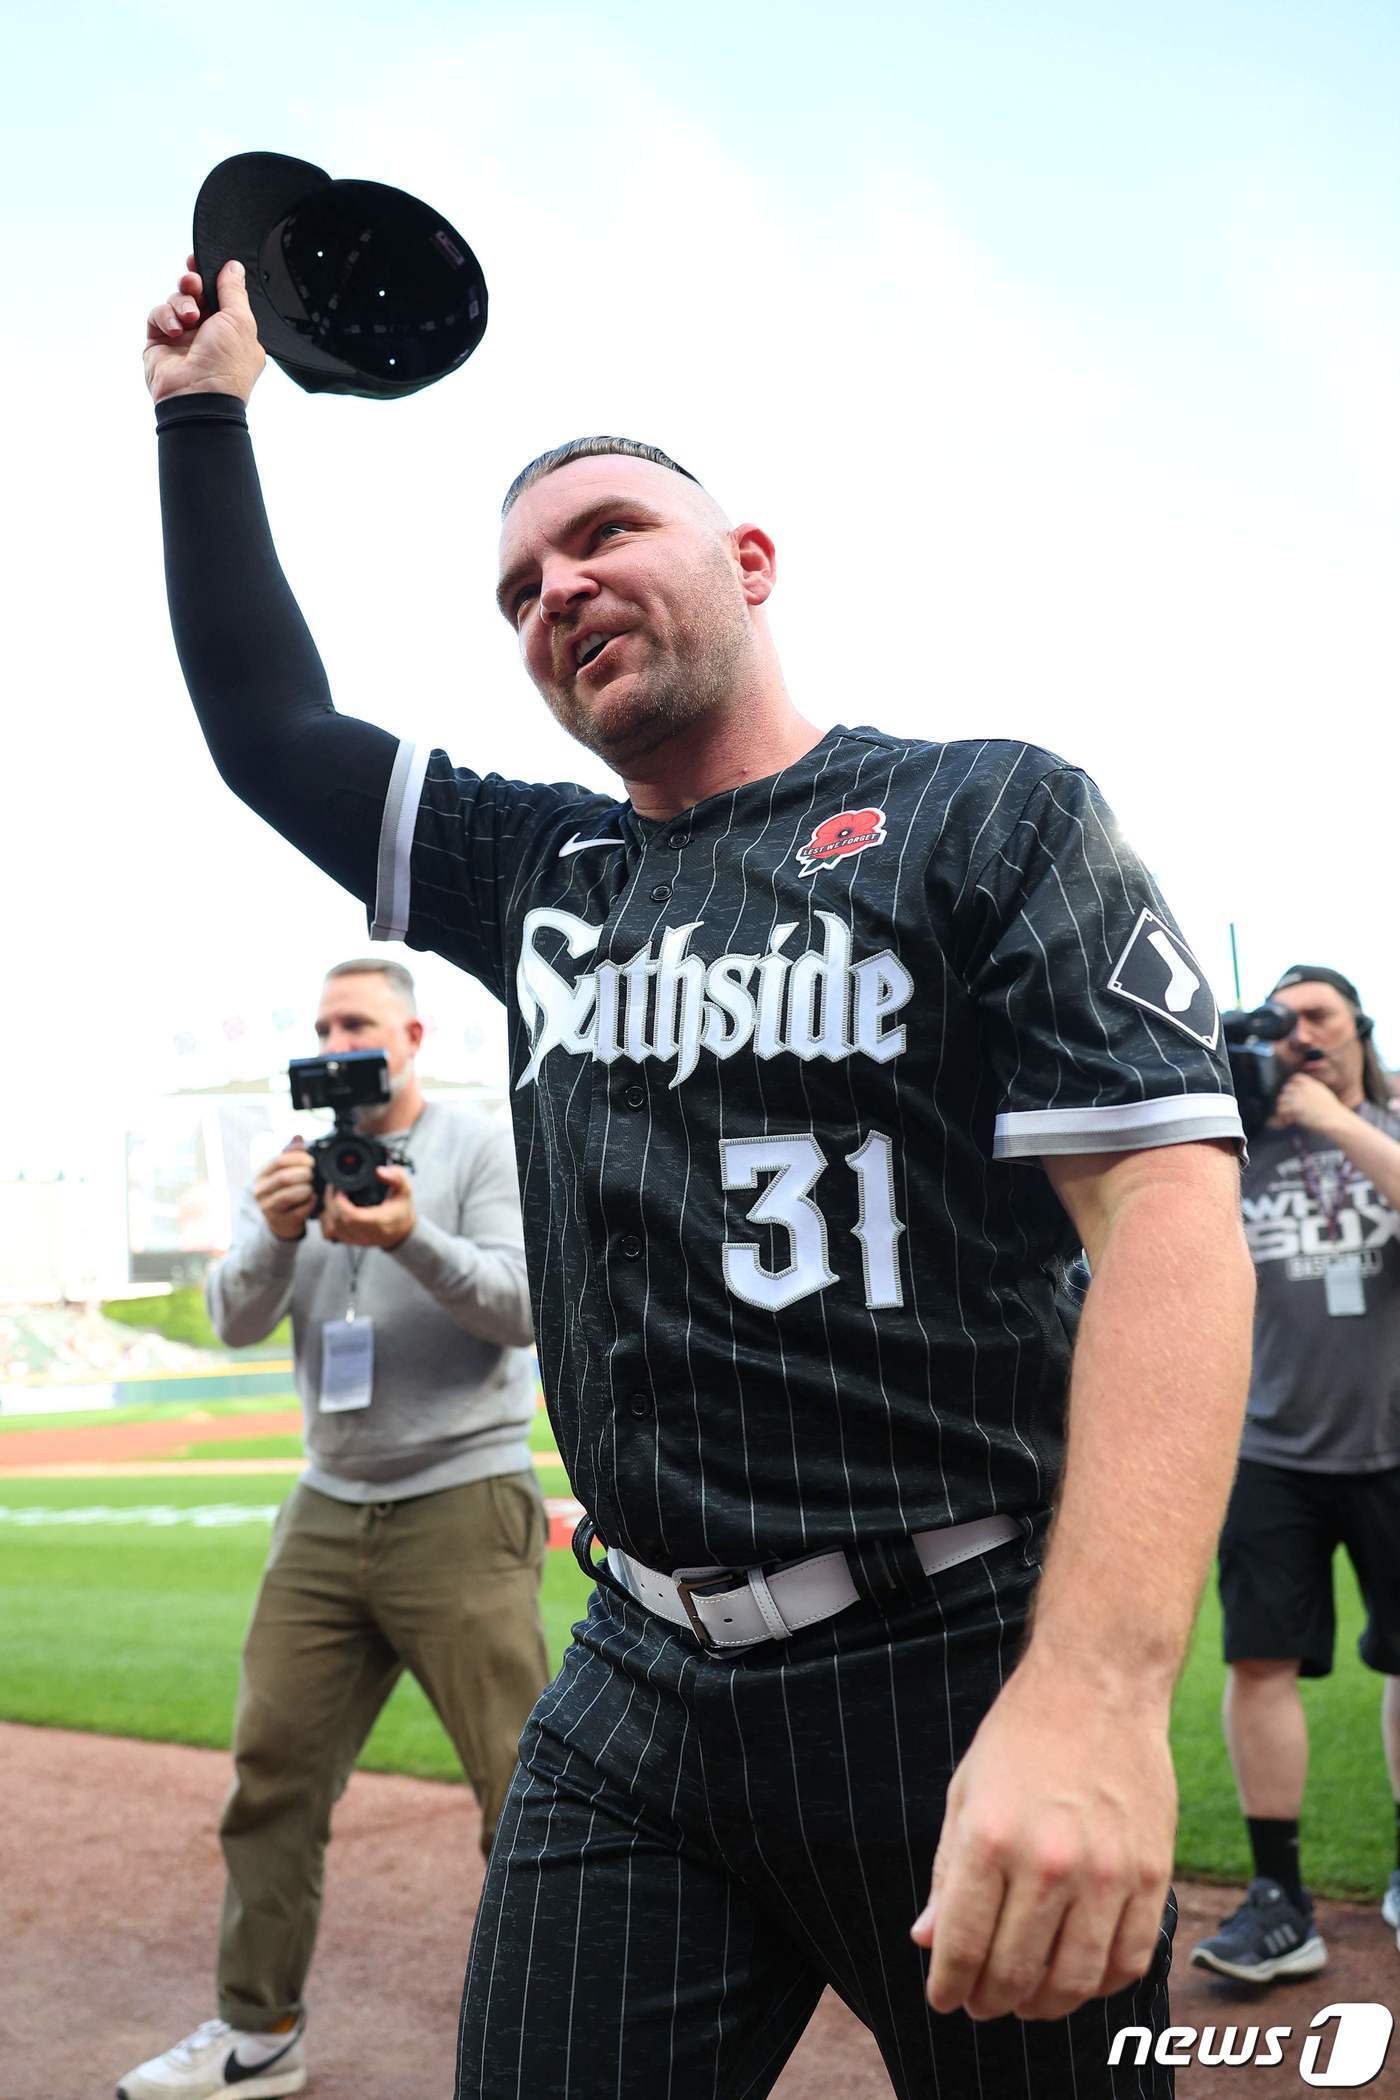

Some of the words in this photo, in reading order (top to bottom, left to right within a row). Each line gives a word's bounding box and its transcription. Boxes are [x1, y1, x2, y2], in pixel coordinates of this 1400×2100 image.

[803, 847, 824, 855] LEST
[827, 843, 840, 851] WE
[842, 834, 876, 846] FORGET
[718, 1129, 907, 1313] 31
[1241, 1181, 1389, 1220] WHT
[1244, 1203, 1400, 1263] SOX
